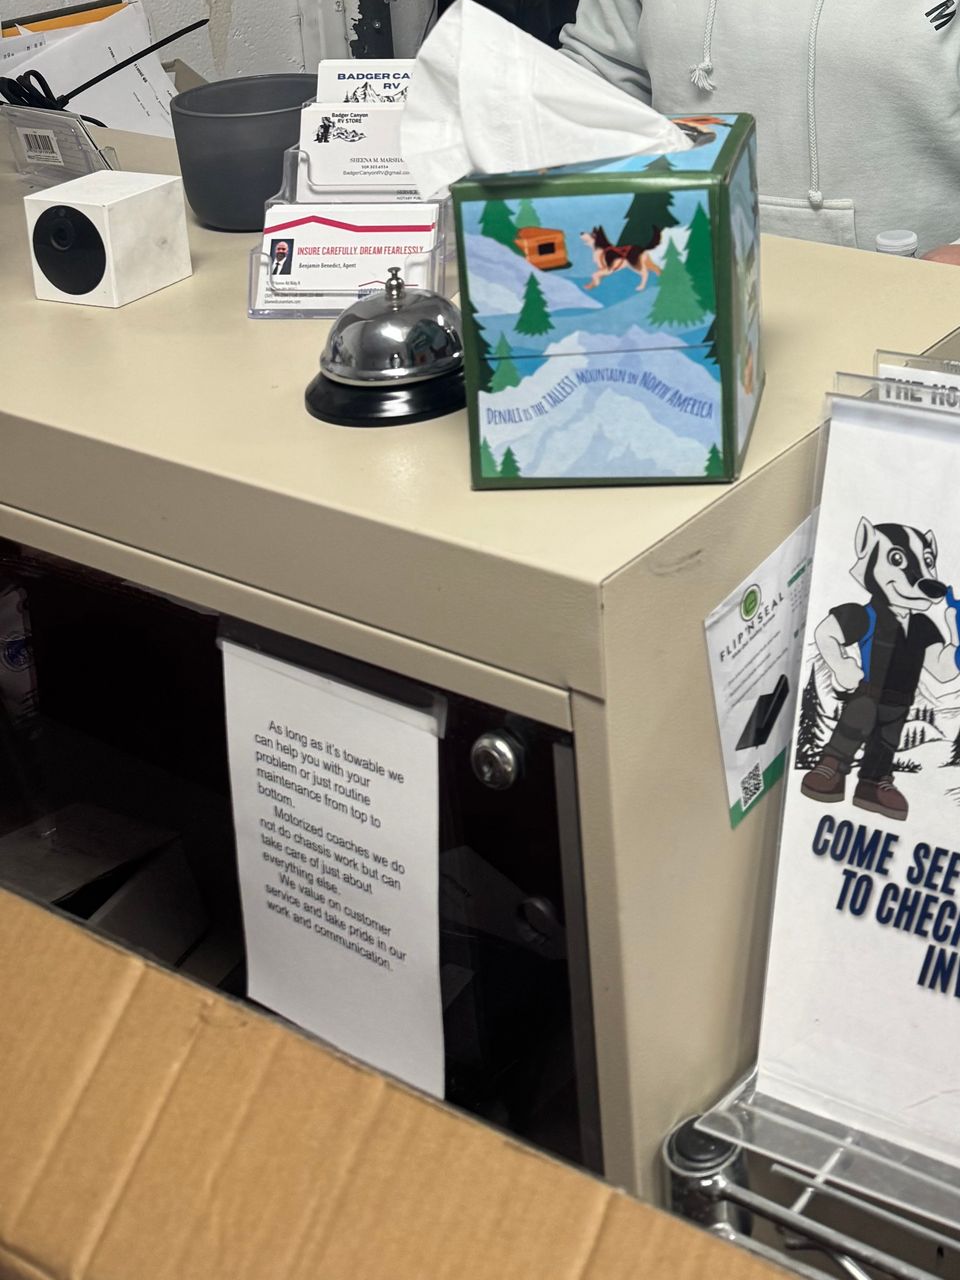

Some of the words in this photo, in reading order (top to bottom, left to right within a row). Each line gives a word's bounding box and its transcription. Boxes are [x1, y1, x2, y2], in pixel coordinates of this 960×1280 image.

[297, 246, 321, 255] INSURE
[360, 246, 383, 255] DREAM
[883, 377, 923, 403] THE
[255, 734, 273, 749] can
[276, 739, 298, 759] help
[301, 752, 320, 766] you
[323, 759, 344, 777] with
[346, 770, 371, 787] your
[256, 751, 297, 774] problem
[300, 768, 310, 780] or
[312, 771, 331, 789] just
[335, 781, 371, 806] routine
[269, 720, 283, 735] As
[286, 726, 308, 747] long
[311, 738, 323, 751] as
[325, 742, 341, 758] it's
[343, 749, 385, 776] towable
[388, 769, 404, 783] we
[256, 768, 322, 803] maintenance
[324, 794, 348, 815] from
[351, 806, 368, 824] top
[370, 814, 381, 828] to
[257, 782, 296, 809] bottom.
[274, 806, 324, 838] Motorized
[326, 831, 370, 859] coaches
[372, 852, 389, 867] we
[391, 861, 406, 875] do
[811, 813, 900, 877] COME
[835, 868, 876, 917] TO
